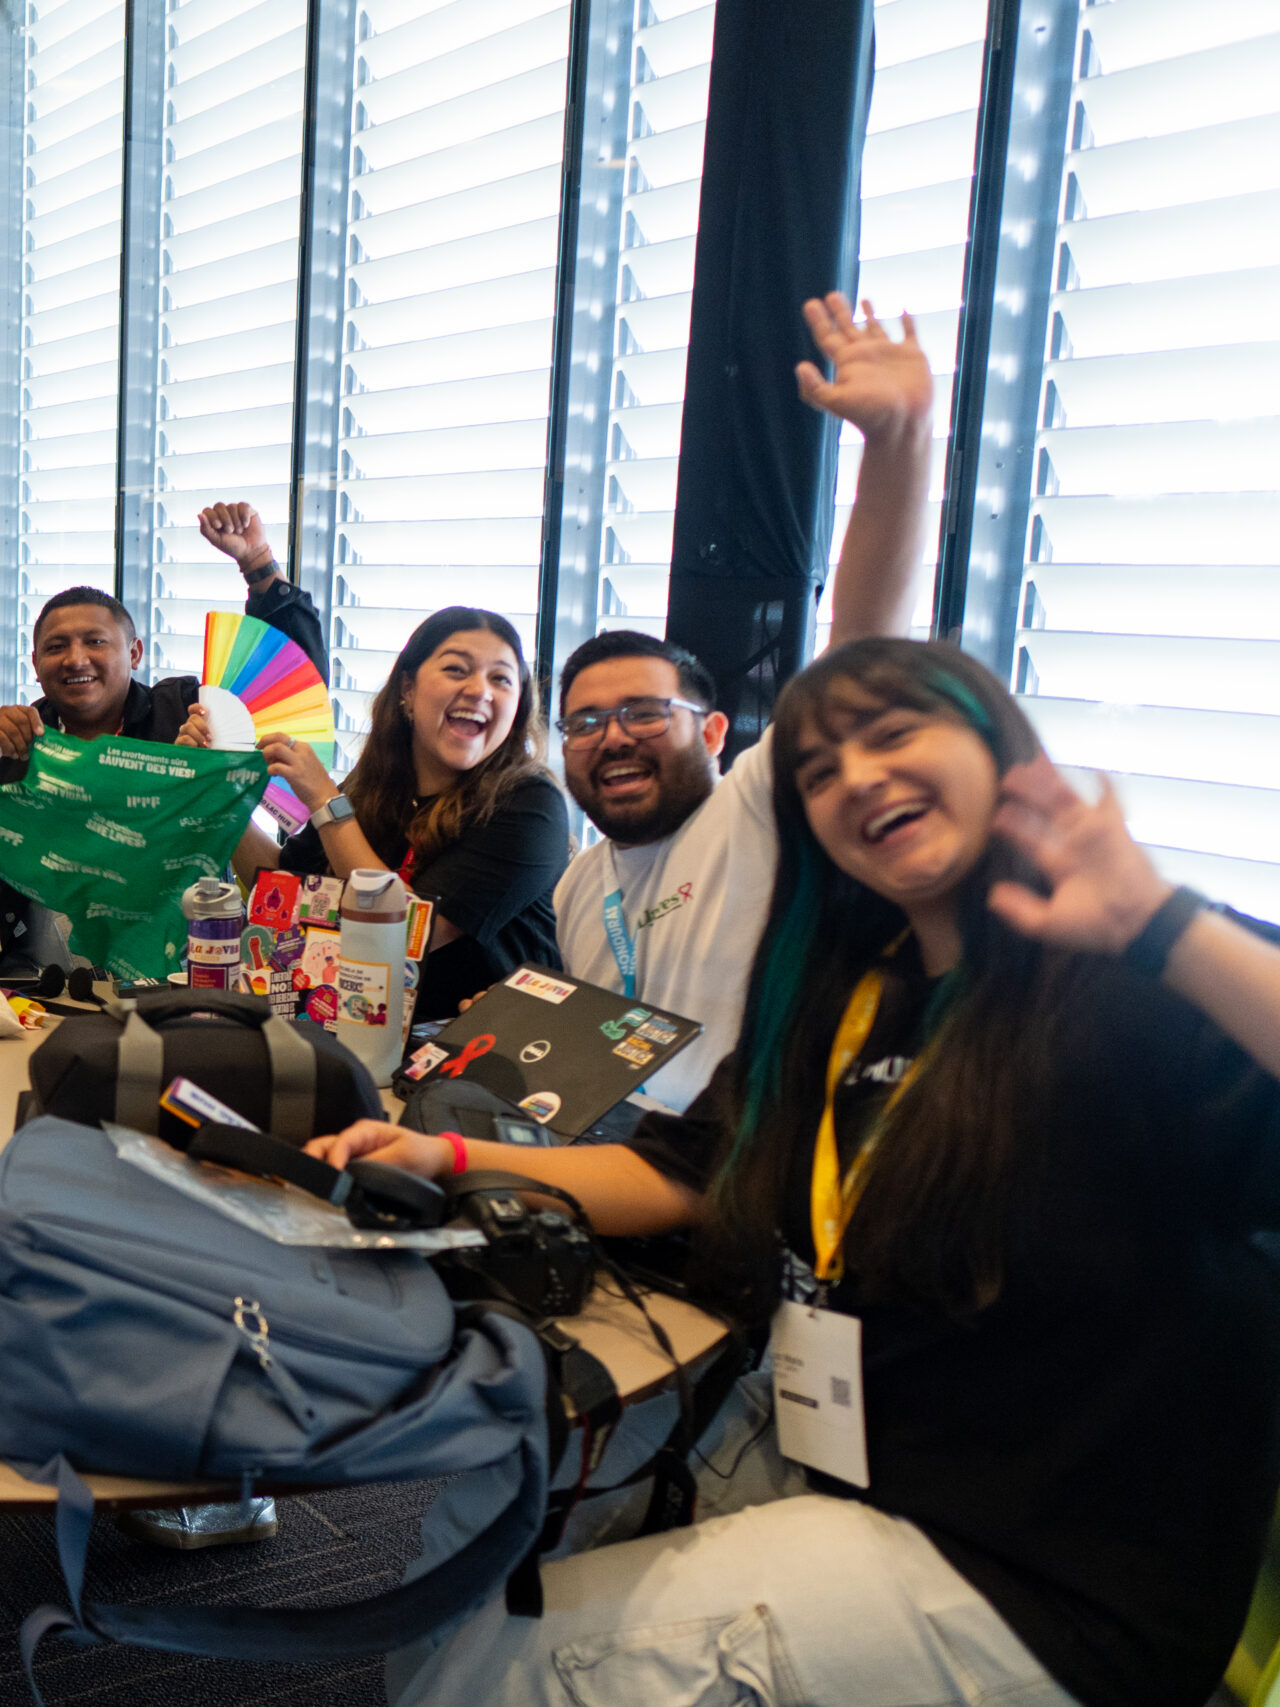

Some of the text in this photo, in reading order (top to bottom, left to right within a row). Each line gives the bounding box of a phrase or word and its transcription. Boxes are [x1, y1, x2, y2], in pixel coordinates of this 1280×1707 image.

[107, 746, 120, 756] Les
[122, 751, 169, 764] avortements
[98, 753, 196, 779] SAUVENT DES VIES!
[126, 795, 160, 808] IPPF
